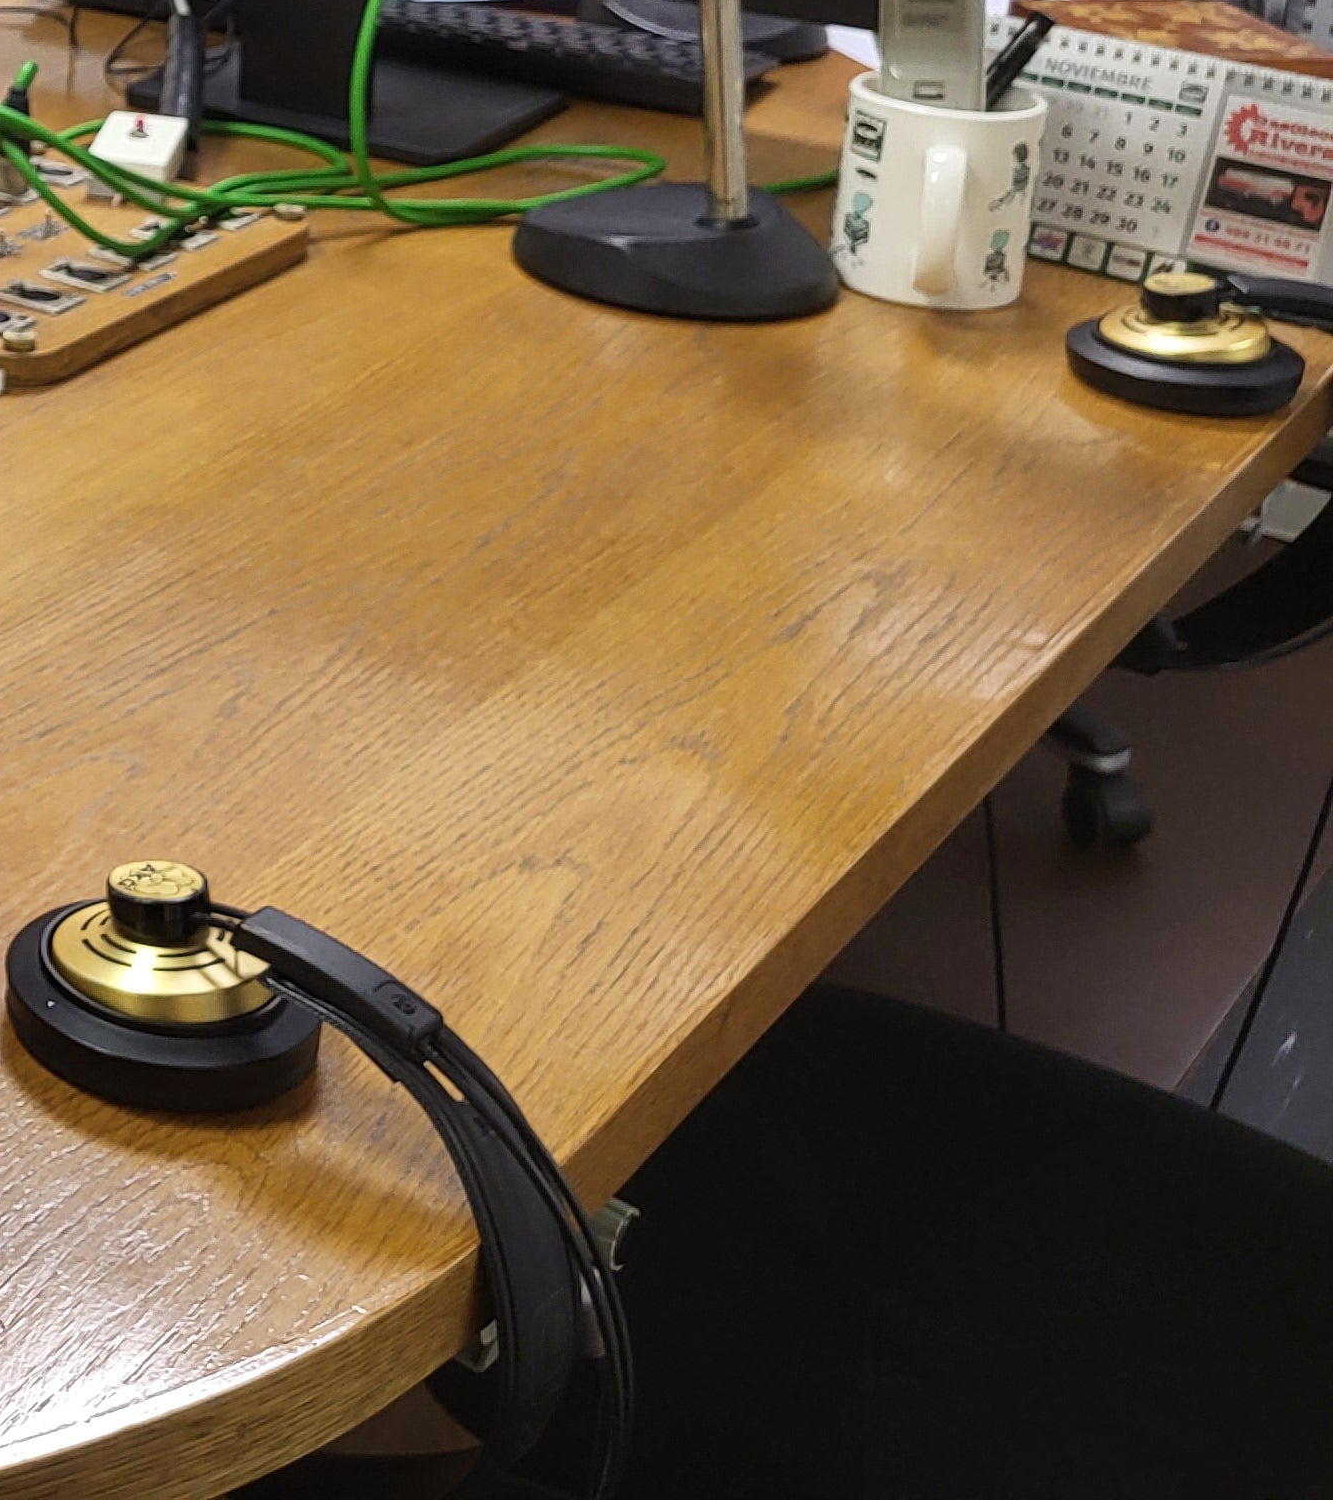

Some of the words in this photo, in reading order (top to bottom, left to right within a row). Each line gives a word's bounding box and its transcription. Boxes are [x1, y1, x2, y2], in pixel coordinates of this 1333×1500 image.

[1044, 57, 1154, 91] NOVIEMBRE
[1124, 111, 1132, 124] 1
[1148, 117, 1160, 131] 2
[1177, 123, 1188, 137] 3
[1088, 129, 1100, 143] 7
[1168, 148, 1186, 164] 10
[1079, 154, 1096, 170] 14
[1133, 167, 1151, 182] 16
[1161, 172, 1178, 188] 17
[1042, 172, 1064, 189] 20
[1070, 179, 1089, 196] 21
[1096, 185, 1117, 201] 22
[1123, 192, 1144, 208] 23
[1151, 198, 1171, 214] 24
[1089, 210, 1110, 226] 29
[1116, 217, 1137, 233] 30
